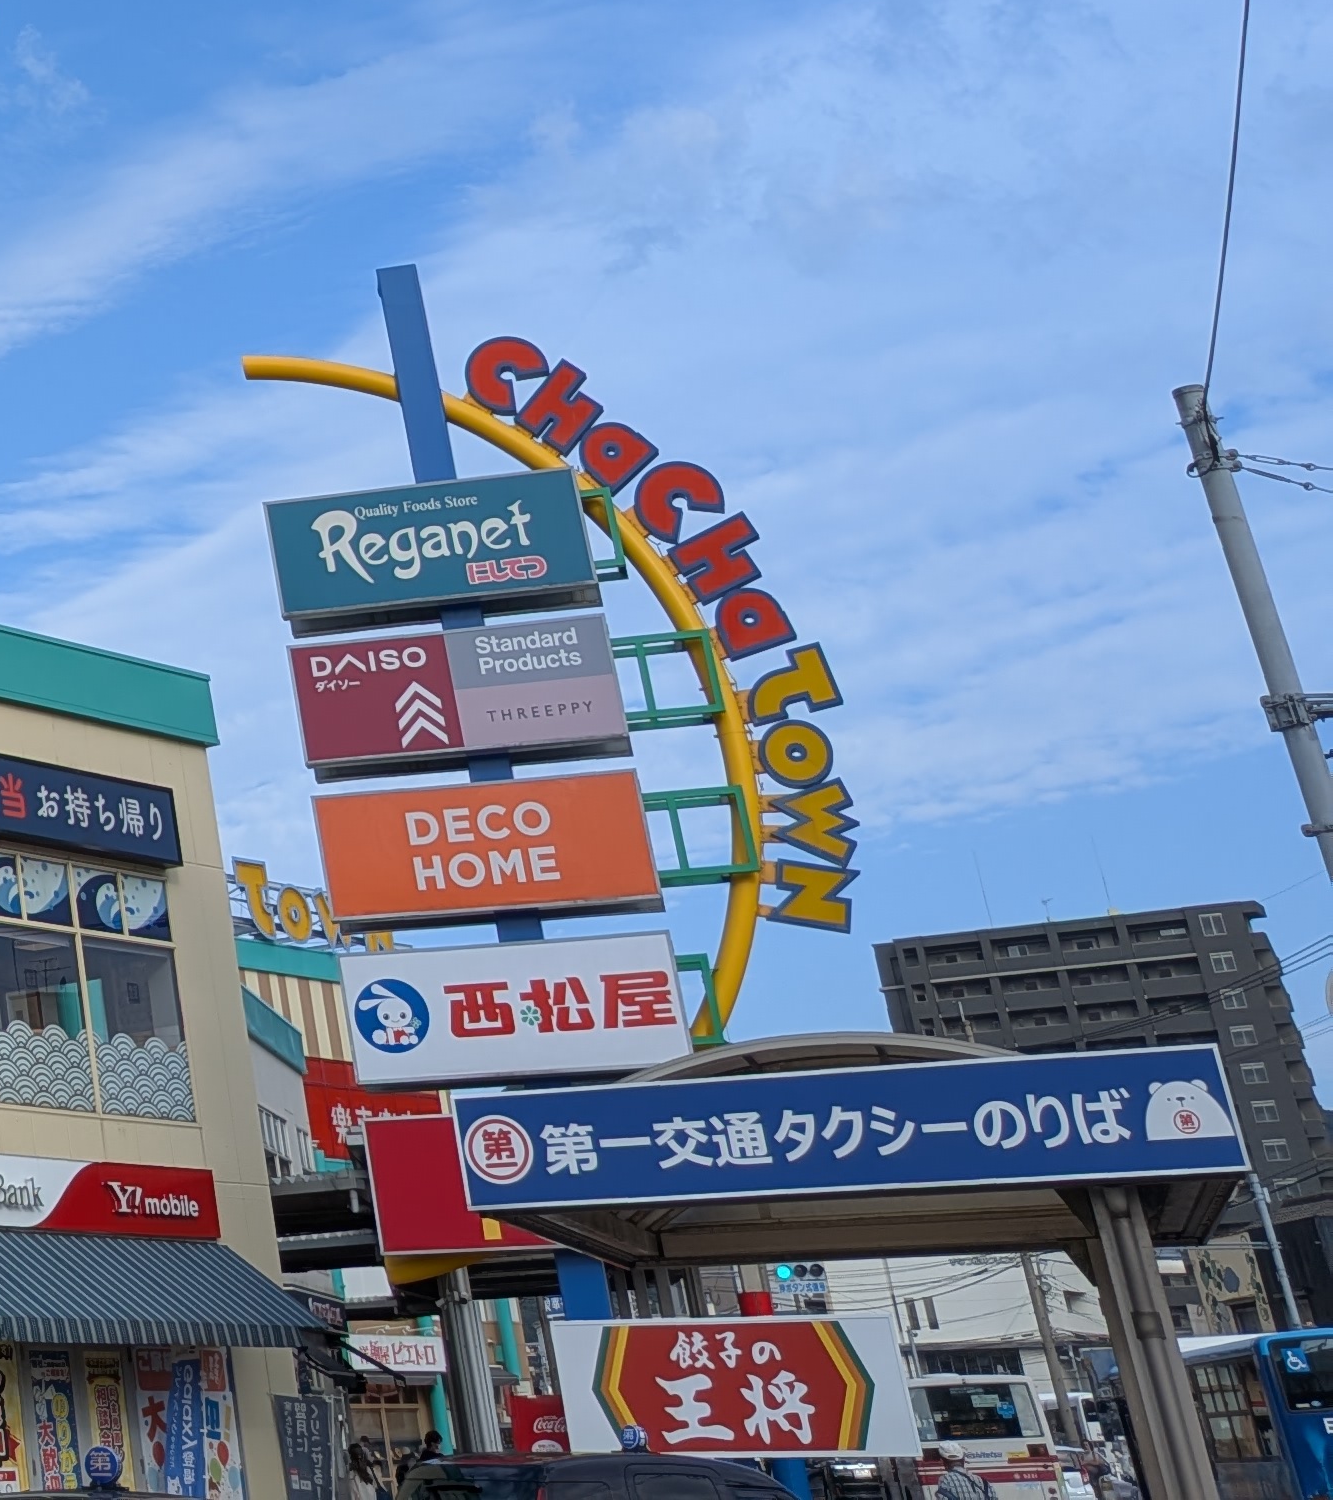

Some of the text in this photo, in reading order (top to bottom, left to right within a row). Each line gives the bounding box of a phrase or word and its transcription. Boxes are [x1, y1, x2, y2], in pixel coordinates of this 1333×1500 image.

[355, 494, 478, 519] Quality Foods Store
[310, 501, 532, 583] Reganet
[474, 627, 578, 654] Standard
[478, 648, 582, 675] Products
[309, 646, 427, 678] DAISO
[315, 677, 361, 692] ダイソー
[486, 700, 593, 723] THREEPPY
[36, 784, 164, 842] お持ち帰り
[405, 801, 550, 846] DECO
[414, 846, 561, 892] HOME
[443, 970, 677, 1037] 西松屋
[540, 1087, 1131, 1175] 第一交通タクシーのりば
[670, 1331, 782, 1370] 餃子の
[656, 1369, 817, 1445] 王将
